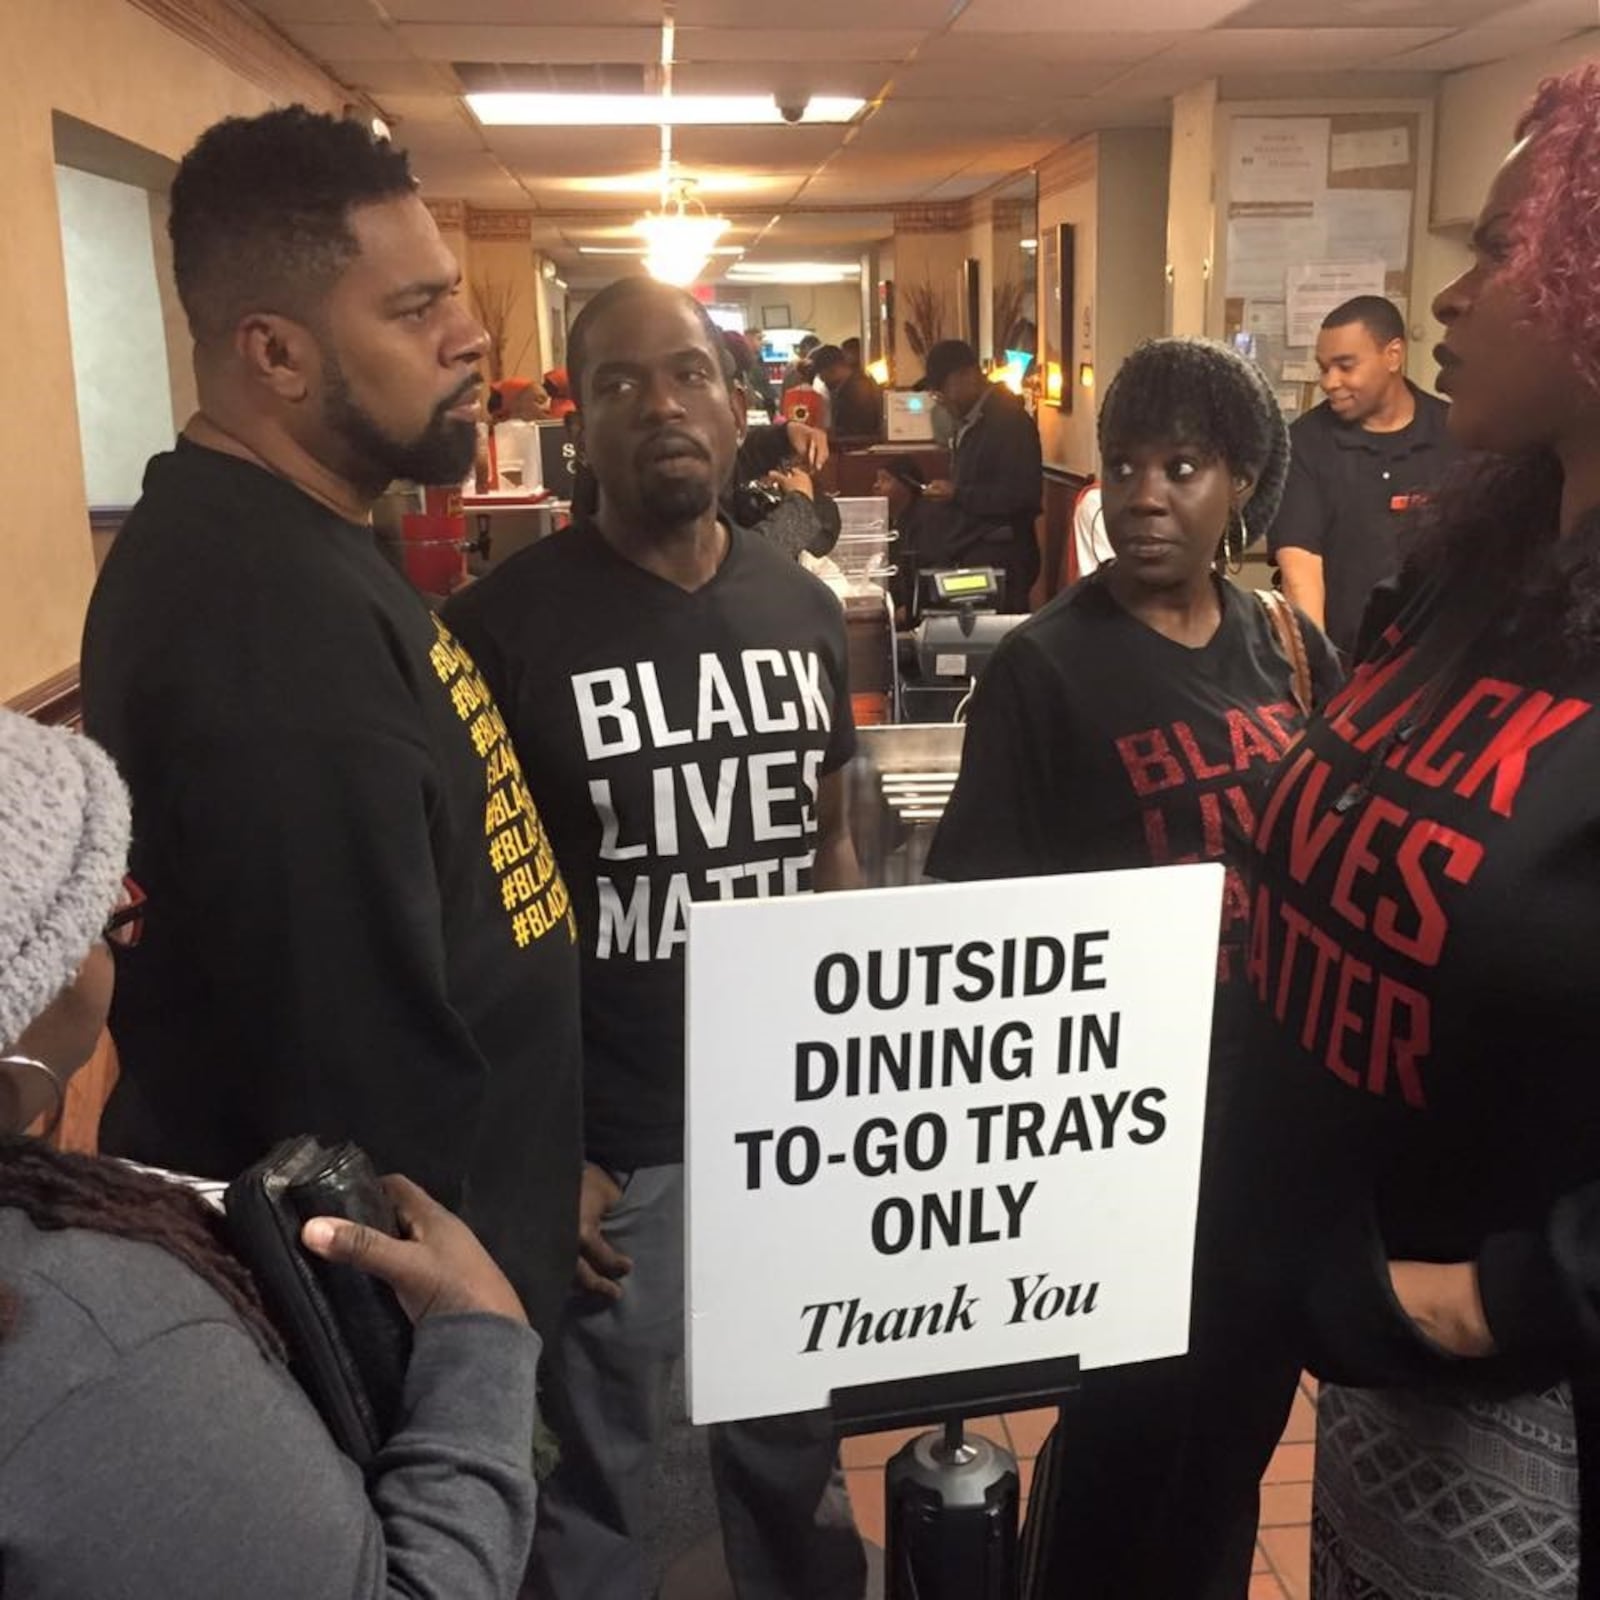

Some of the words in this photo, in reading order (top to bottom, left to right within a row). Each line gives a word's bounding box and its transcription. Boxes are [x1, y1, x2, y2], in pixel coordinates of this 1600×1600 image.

[571, 649, 831, 761] BLACK
[1115, 702, 1302, 798] BLAC
[589, 750, 826, 860] LIVES
[596, 849, 817, 962] MATTE
[1256, 749, 1486, 967] IVES
[814, 930, 1109, 1015] OUTSIDE
[1246, 884, 1432, 1109] ATTER
[795, 1021, 1033, 1102] DINING
[1057, 1011, 1121, 1075] IN
[734, 1112, 947, 1190] TO-GO
[966, 1087, 1167, 1164] TRAYS
[871, 1181, 1037, 1256] ONLY
[799, 1283, 980, 1354] Thank
[1004, 1273, 1100, 1326] You
